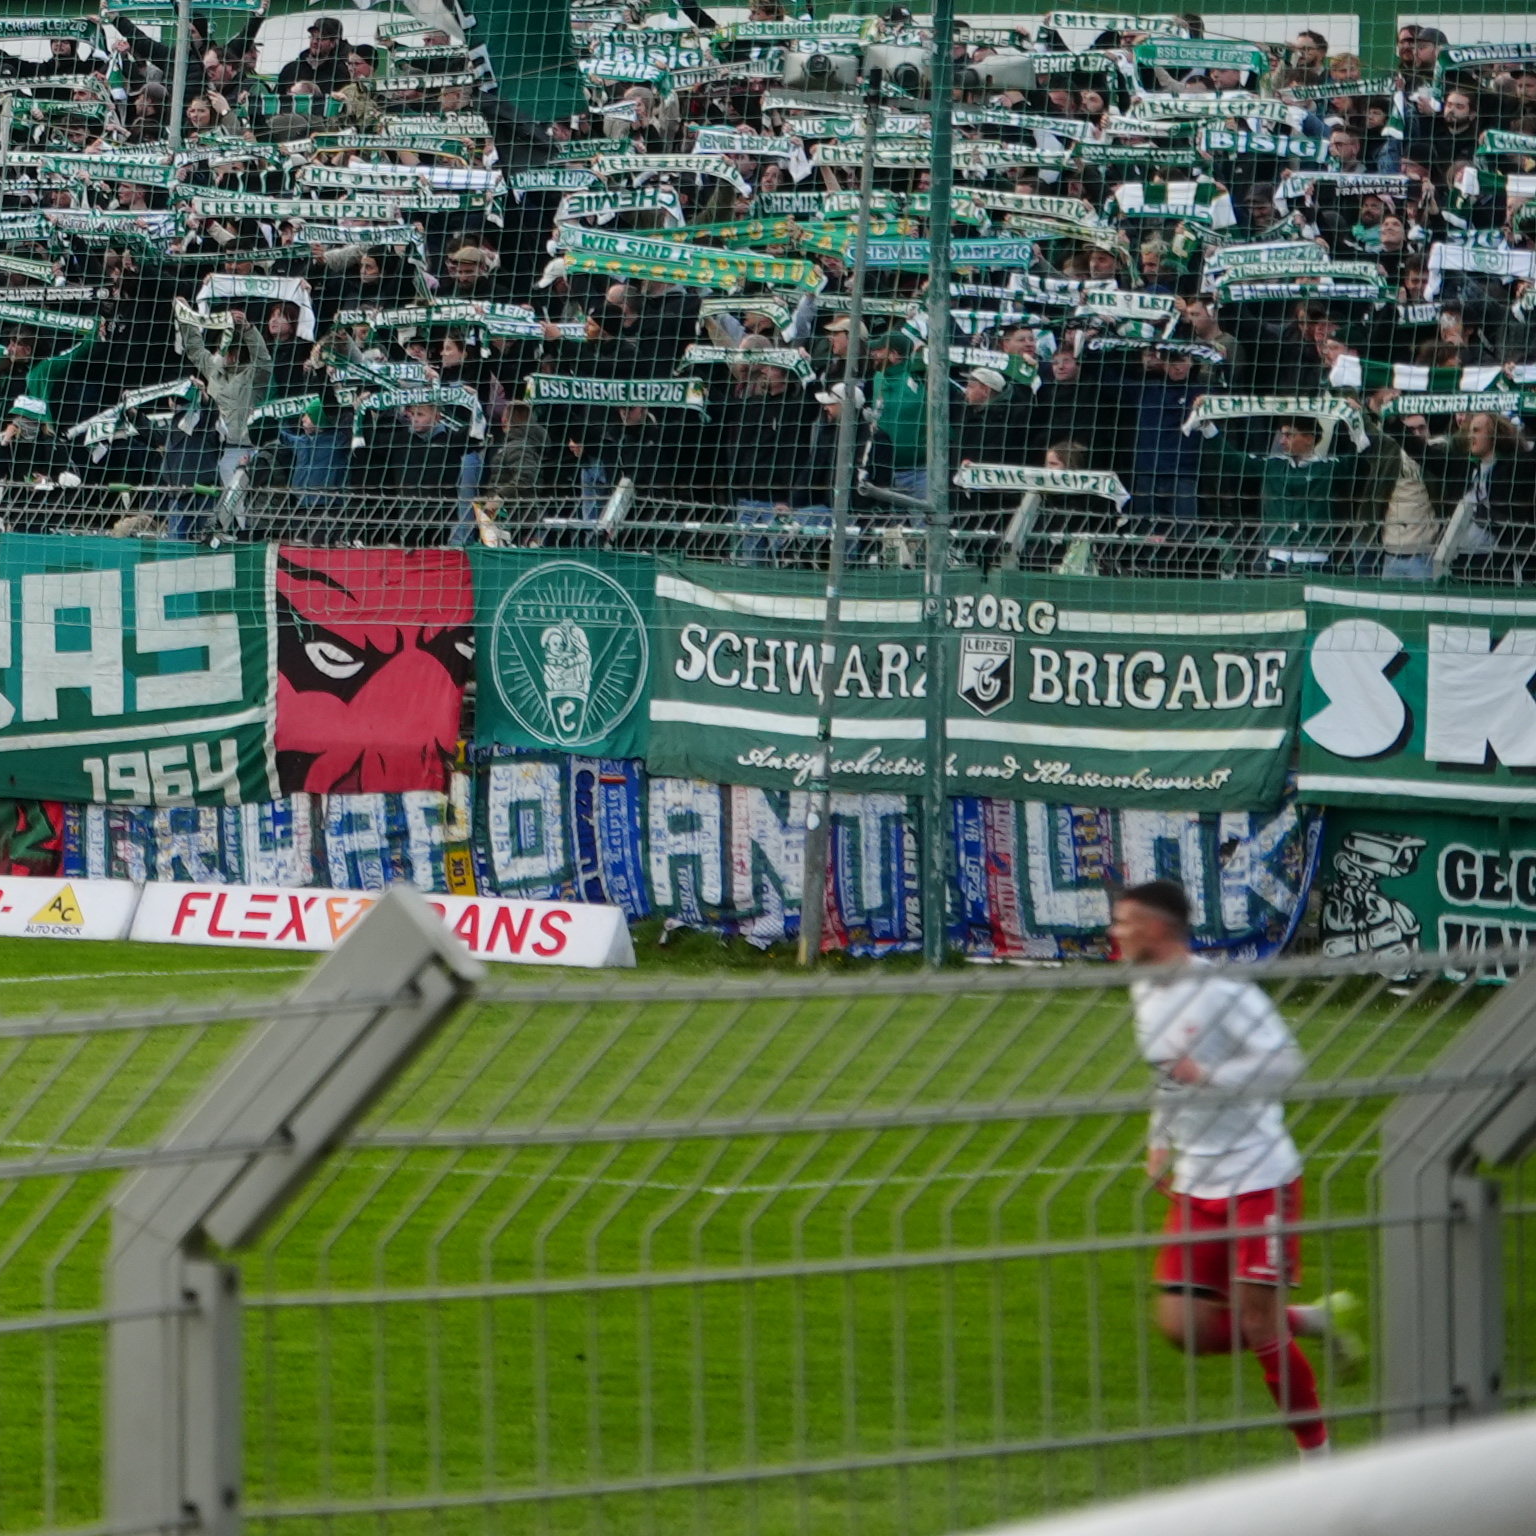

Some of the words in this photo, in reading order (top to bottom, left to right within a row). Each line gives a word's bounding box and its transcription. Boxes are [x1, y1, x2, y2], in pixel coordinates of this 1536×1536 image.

[571, 380, 625, 400] CHEMIE
[628, 383, 684, 403] LEIPZIG
[966, 638, 1010, 652] LEIPZIG
[1029, 647, 1287, 710] BRIGADE
[82, 738, 241, 805] 1964
[49, 894, 77, 924] AC
[170, 891, 318, 941] FLEX
